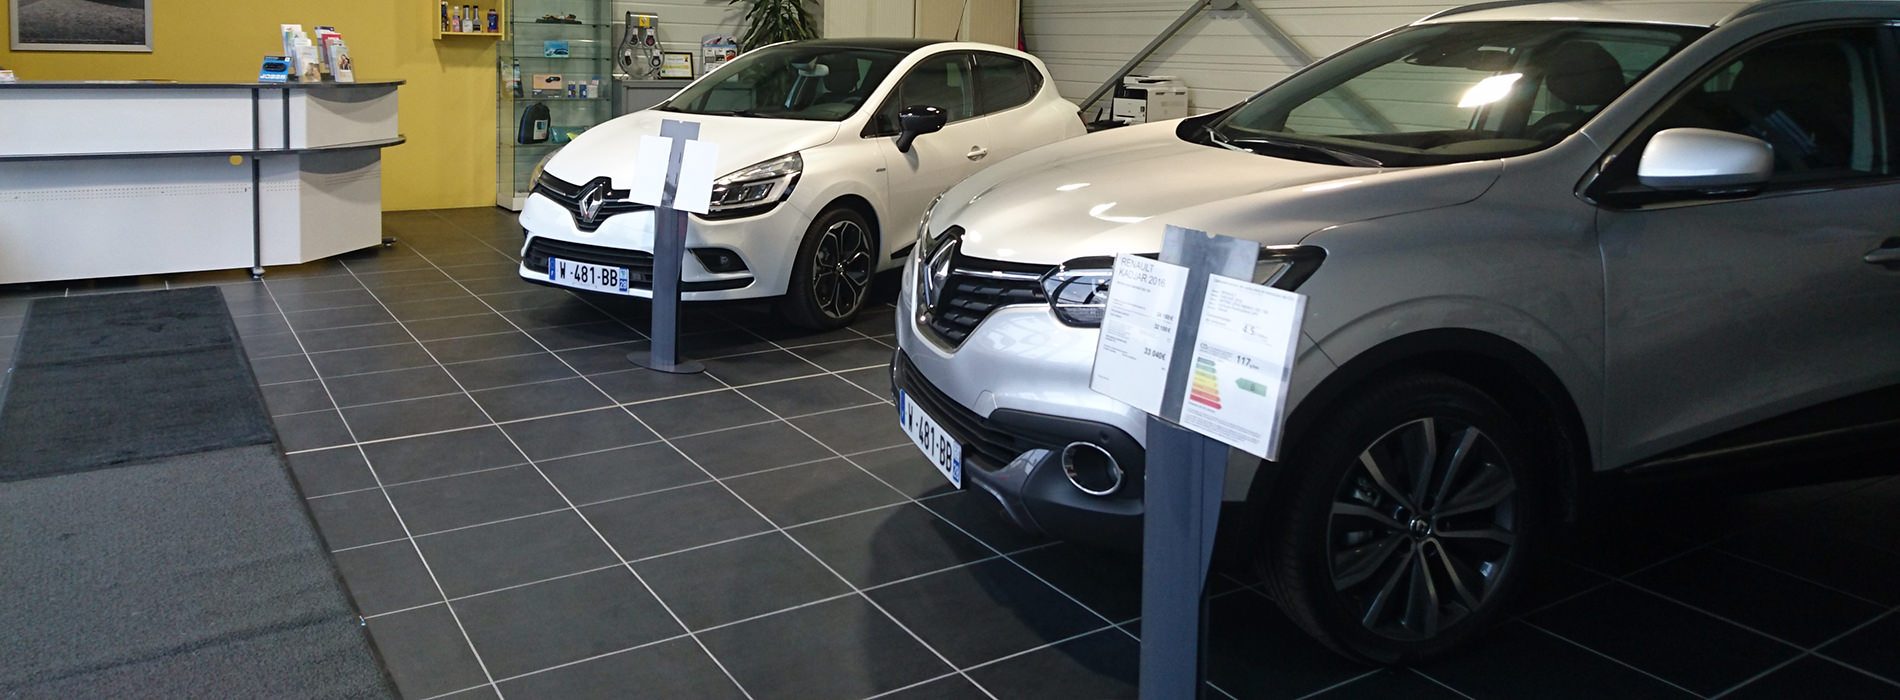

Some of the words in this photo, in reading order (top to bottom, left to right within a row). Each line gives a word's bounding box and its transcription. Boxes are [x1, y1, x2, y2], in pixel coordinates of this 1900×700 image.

[1121, 257, 1154, 272] RENAULT
[1119, 269, 1147, 284] KADJAR
[1237, 355, 1251, 367] 117
